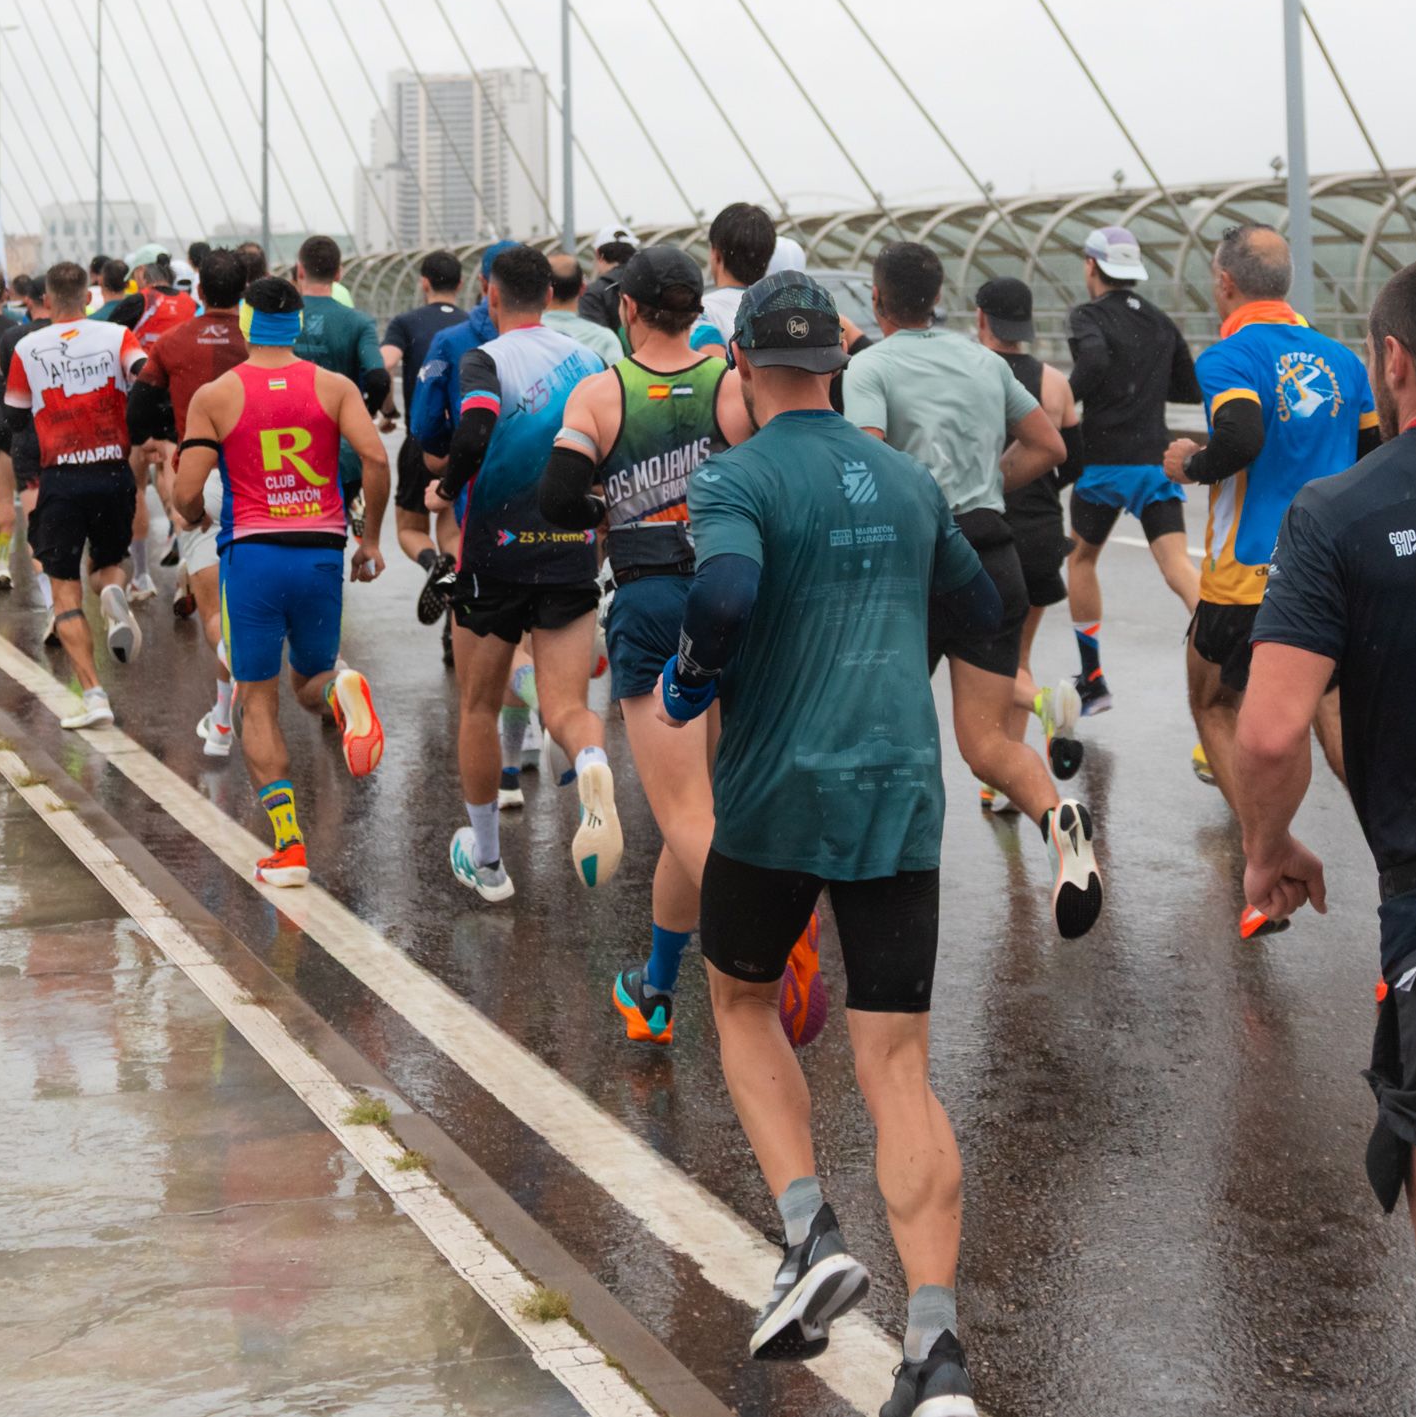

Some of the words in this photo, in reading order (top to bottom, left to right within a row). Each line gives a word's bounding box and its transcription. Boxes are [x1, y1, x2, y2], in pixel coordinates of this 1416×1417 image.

[57, 444, 123, 465] NAVARRO
[260, 426, 330, 486] R
[265, 474, 296, 490] CLUB
[267, 486, 322, 506] MARATÓN
[269, 503, 322, 518] RIOJA
[855, 524, 894, 536] MARATÓN
